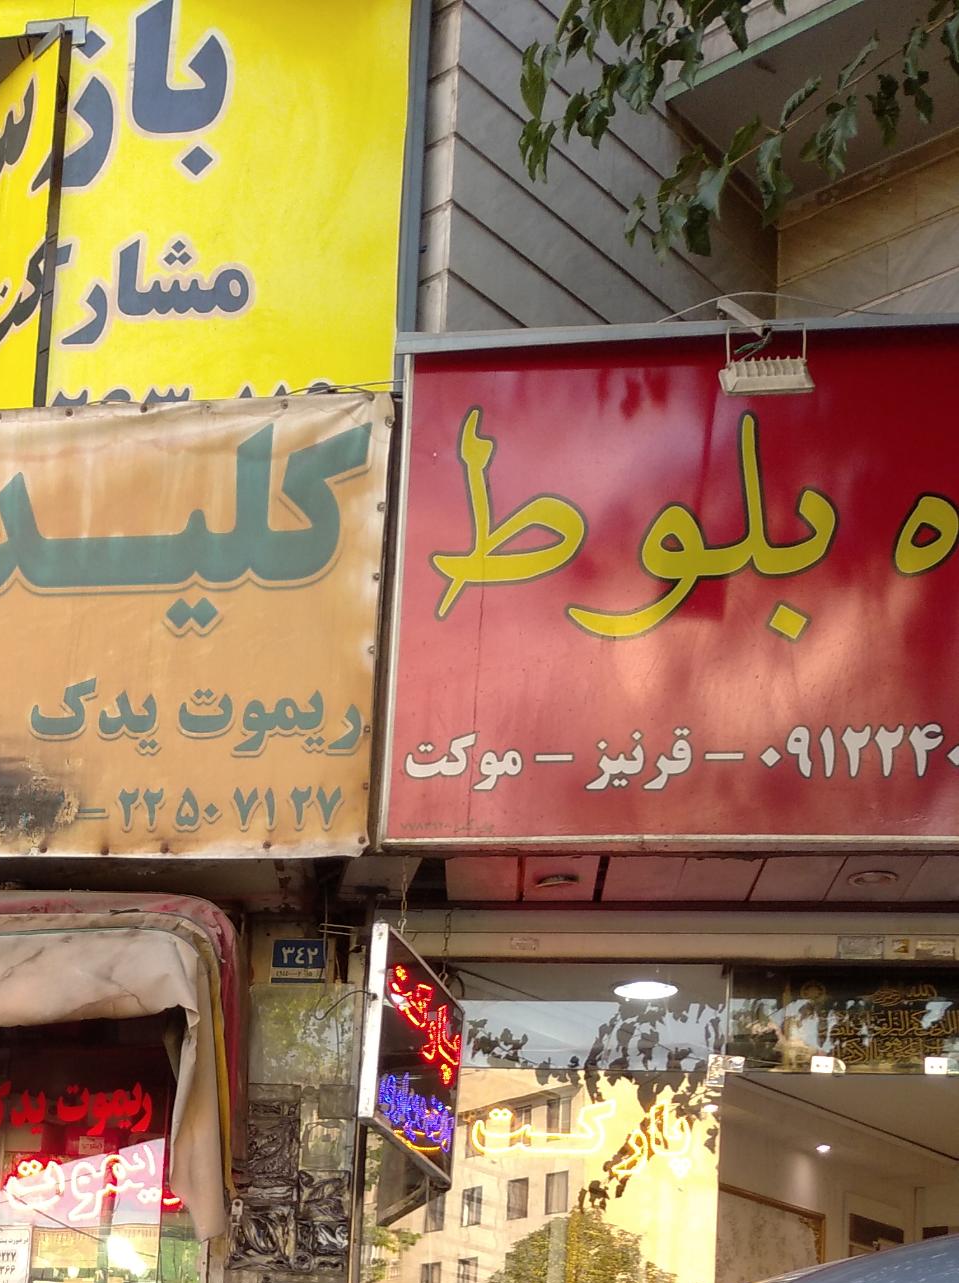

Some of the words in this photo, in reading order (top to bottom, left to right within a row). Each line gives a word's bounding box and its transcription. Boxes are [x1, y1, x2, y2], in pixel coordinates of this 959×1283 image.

[431, 407, 839, 640] بلوط
[29, 678, 159, 754] یدک
[178, 684, 367, 753] ریموت
[404, 733, 524, 790] موکت
[587, 727, 693, 790] قرنیز
[56, 1081, 153, 1136] ریموت
[471, 1100, 692, 1177] پارکت
